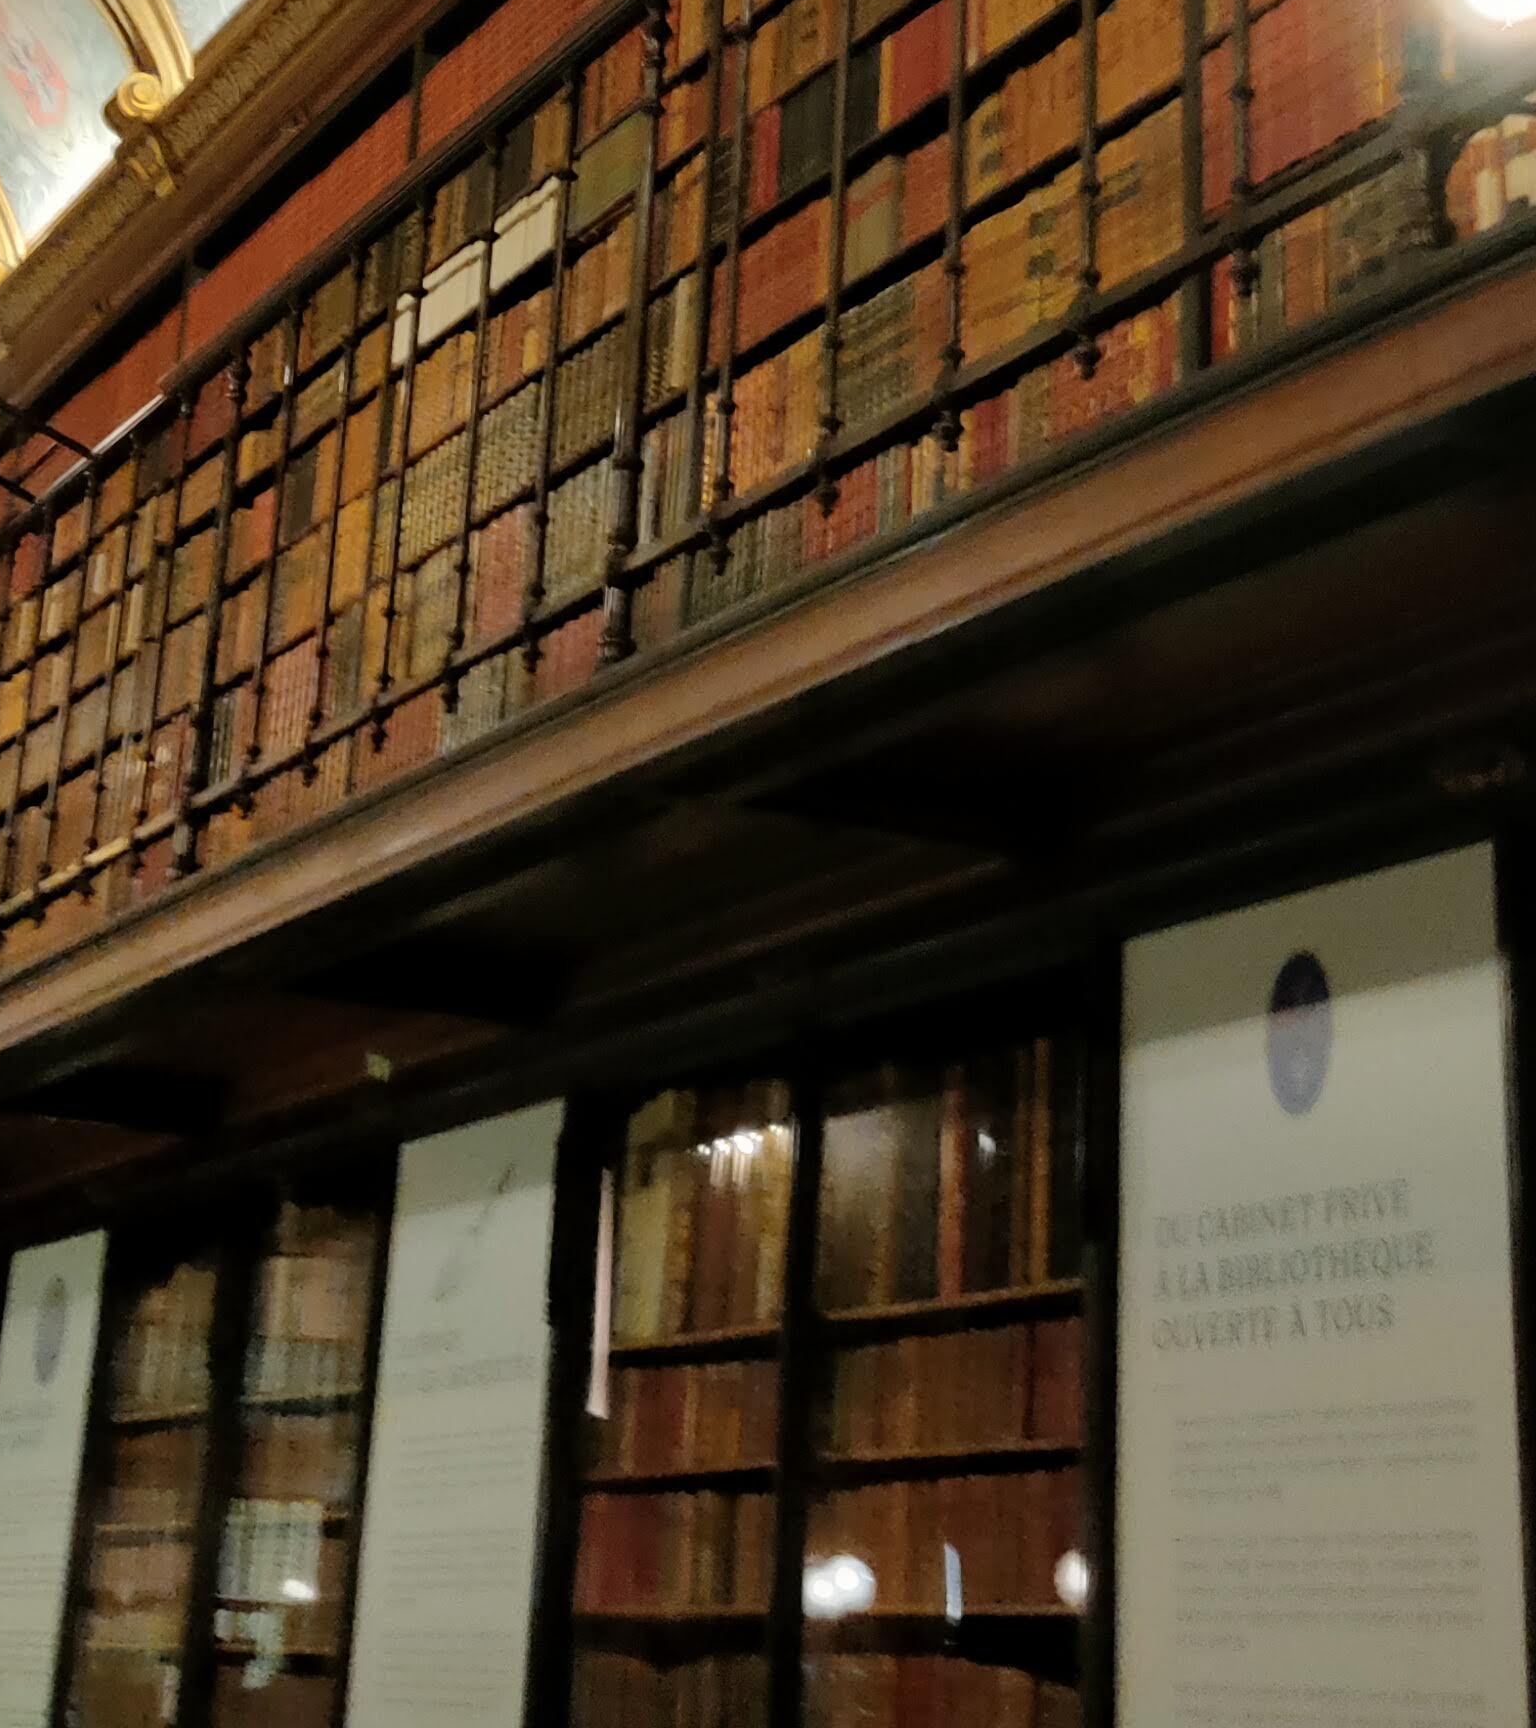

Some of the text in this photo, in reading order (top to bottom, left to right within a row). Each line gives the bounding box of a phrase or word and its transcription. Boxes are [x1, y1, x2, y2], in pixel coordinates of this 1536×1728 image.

[1197, 1191, 1314, 1247] CABINET
[1178, 1262, 1210, 1299] LA
[1151, 1304, 1279, 1351] OUVERTE
[1314, 1292, 1396, 1338] TOUS
